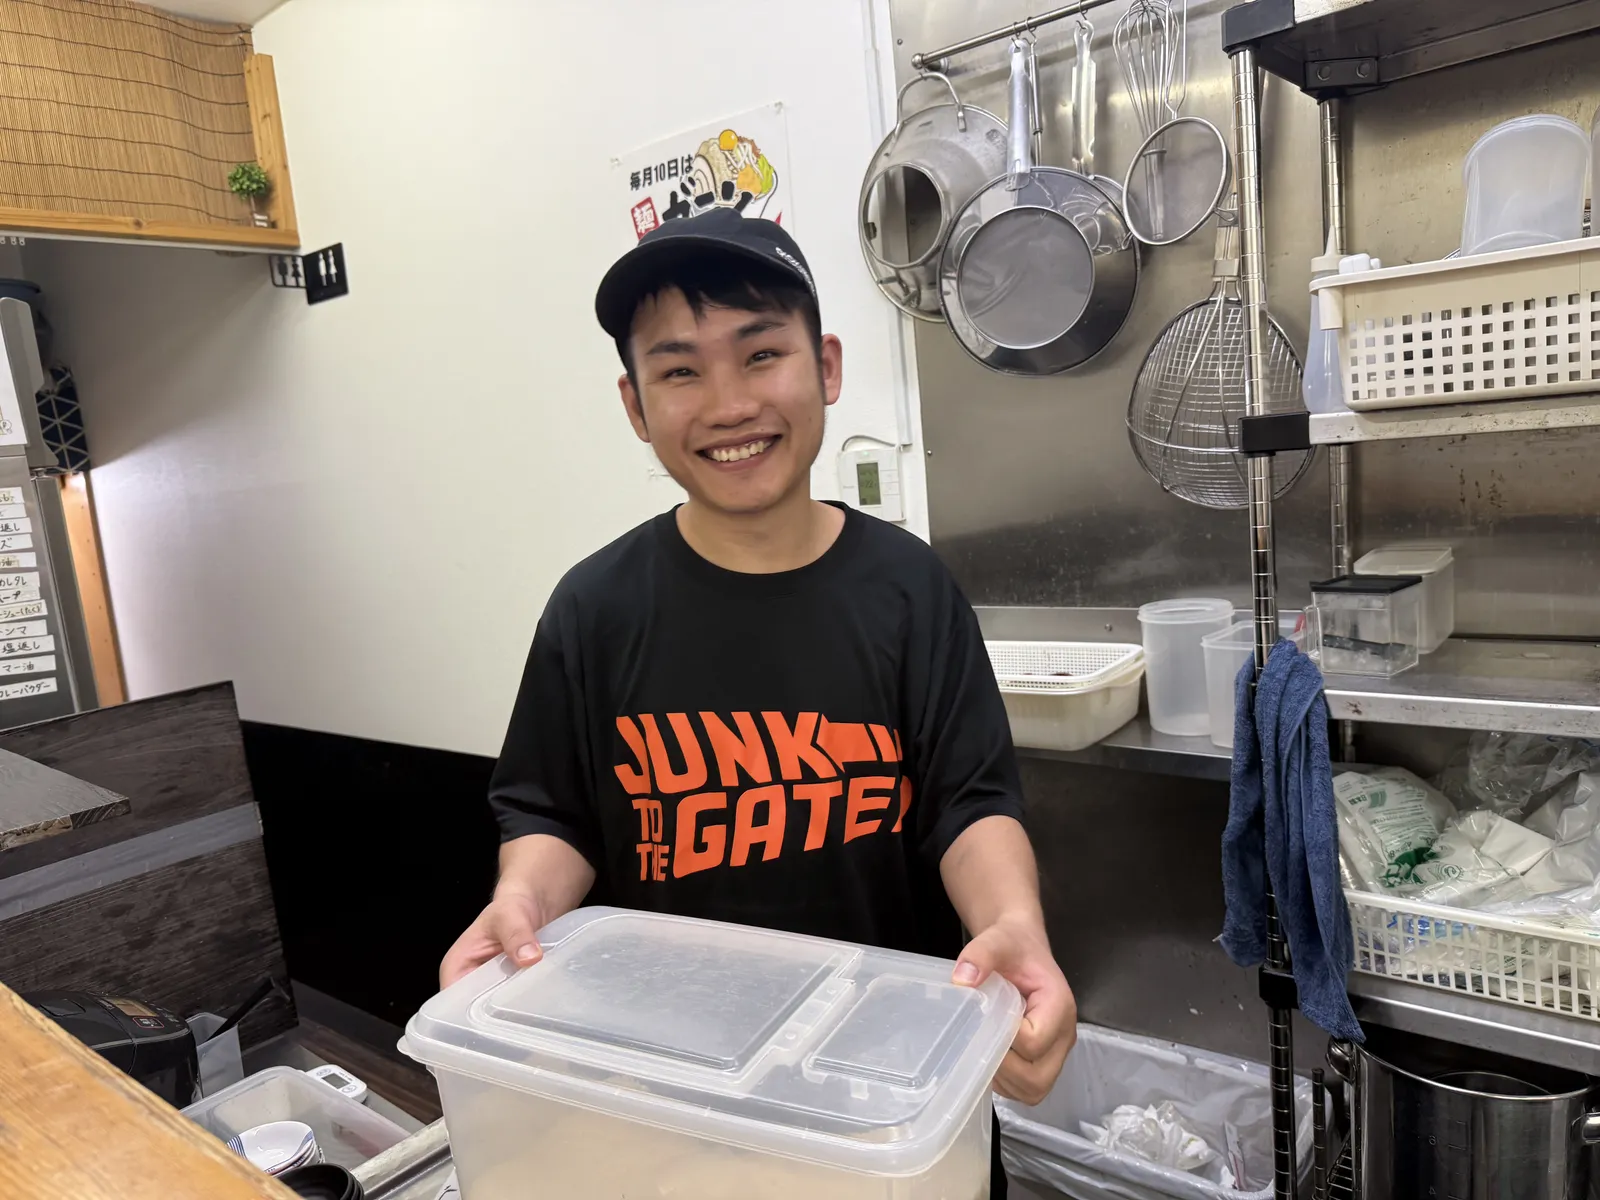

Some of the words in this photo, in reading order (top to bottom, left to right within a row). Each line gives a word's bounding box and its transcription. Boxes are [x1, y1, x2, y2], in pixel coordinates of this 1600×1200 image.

[630, 154, 694, 191] 毎月10日は
[631, 798, 664, 843] TO
